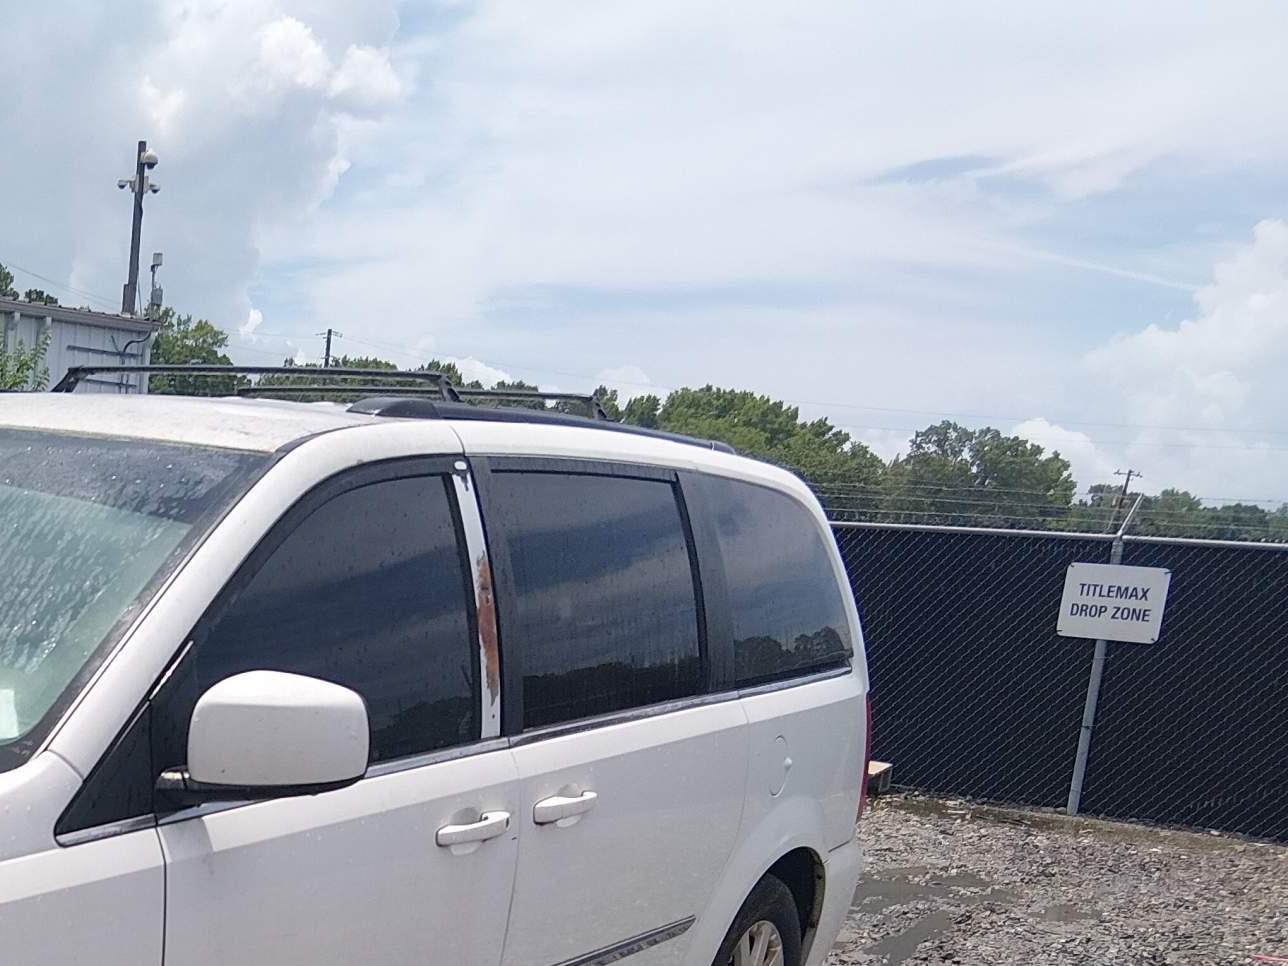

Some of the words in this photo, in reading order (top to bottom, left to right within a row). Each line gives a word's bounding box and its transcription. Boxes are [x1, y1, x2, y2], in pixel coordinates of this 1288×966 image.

[1079, 583, 1151, 601] TITLEMAX
[1070, 603, 1108, 618] DROP
[1111, 606, 1152, 622] ZONE
